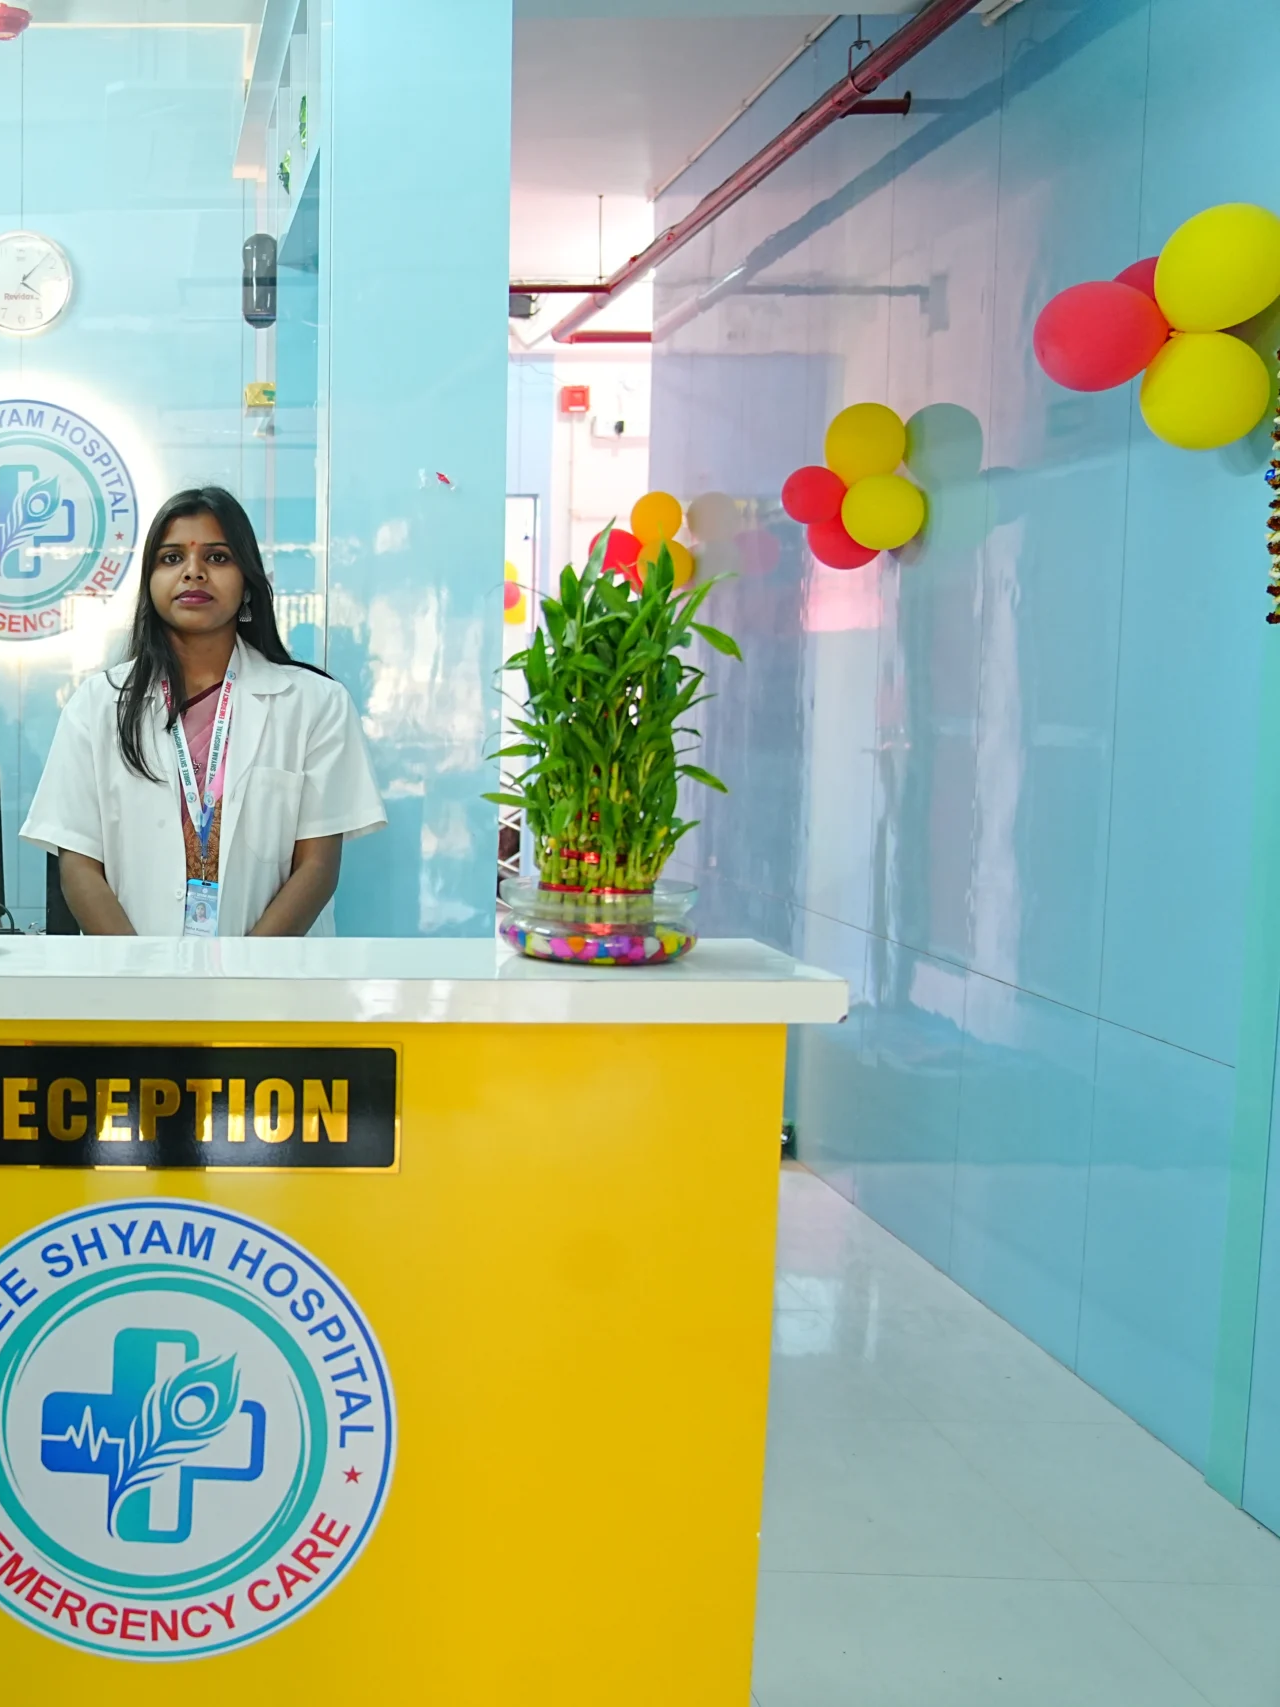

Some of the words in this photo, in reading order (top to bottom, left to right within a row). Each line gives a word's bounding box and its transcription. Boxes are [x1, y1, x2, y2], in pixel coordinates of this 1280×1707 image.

[51, 416, 130, 522] HOSPITAL
[40, 1220, 217, 1280] SHYAM
[228, 1239, 375, 1449] HOSPITAL
[247, 1511, 352, 1612] CARE
